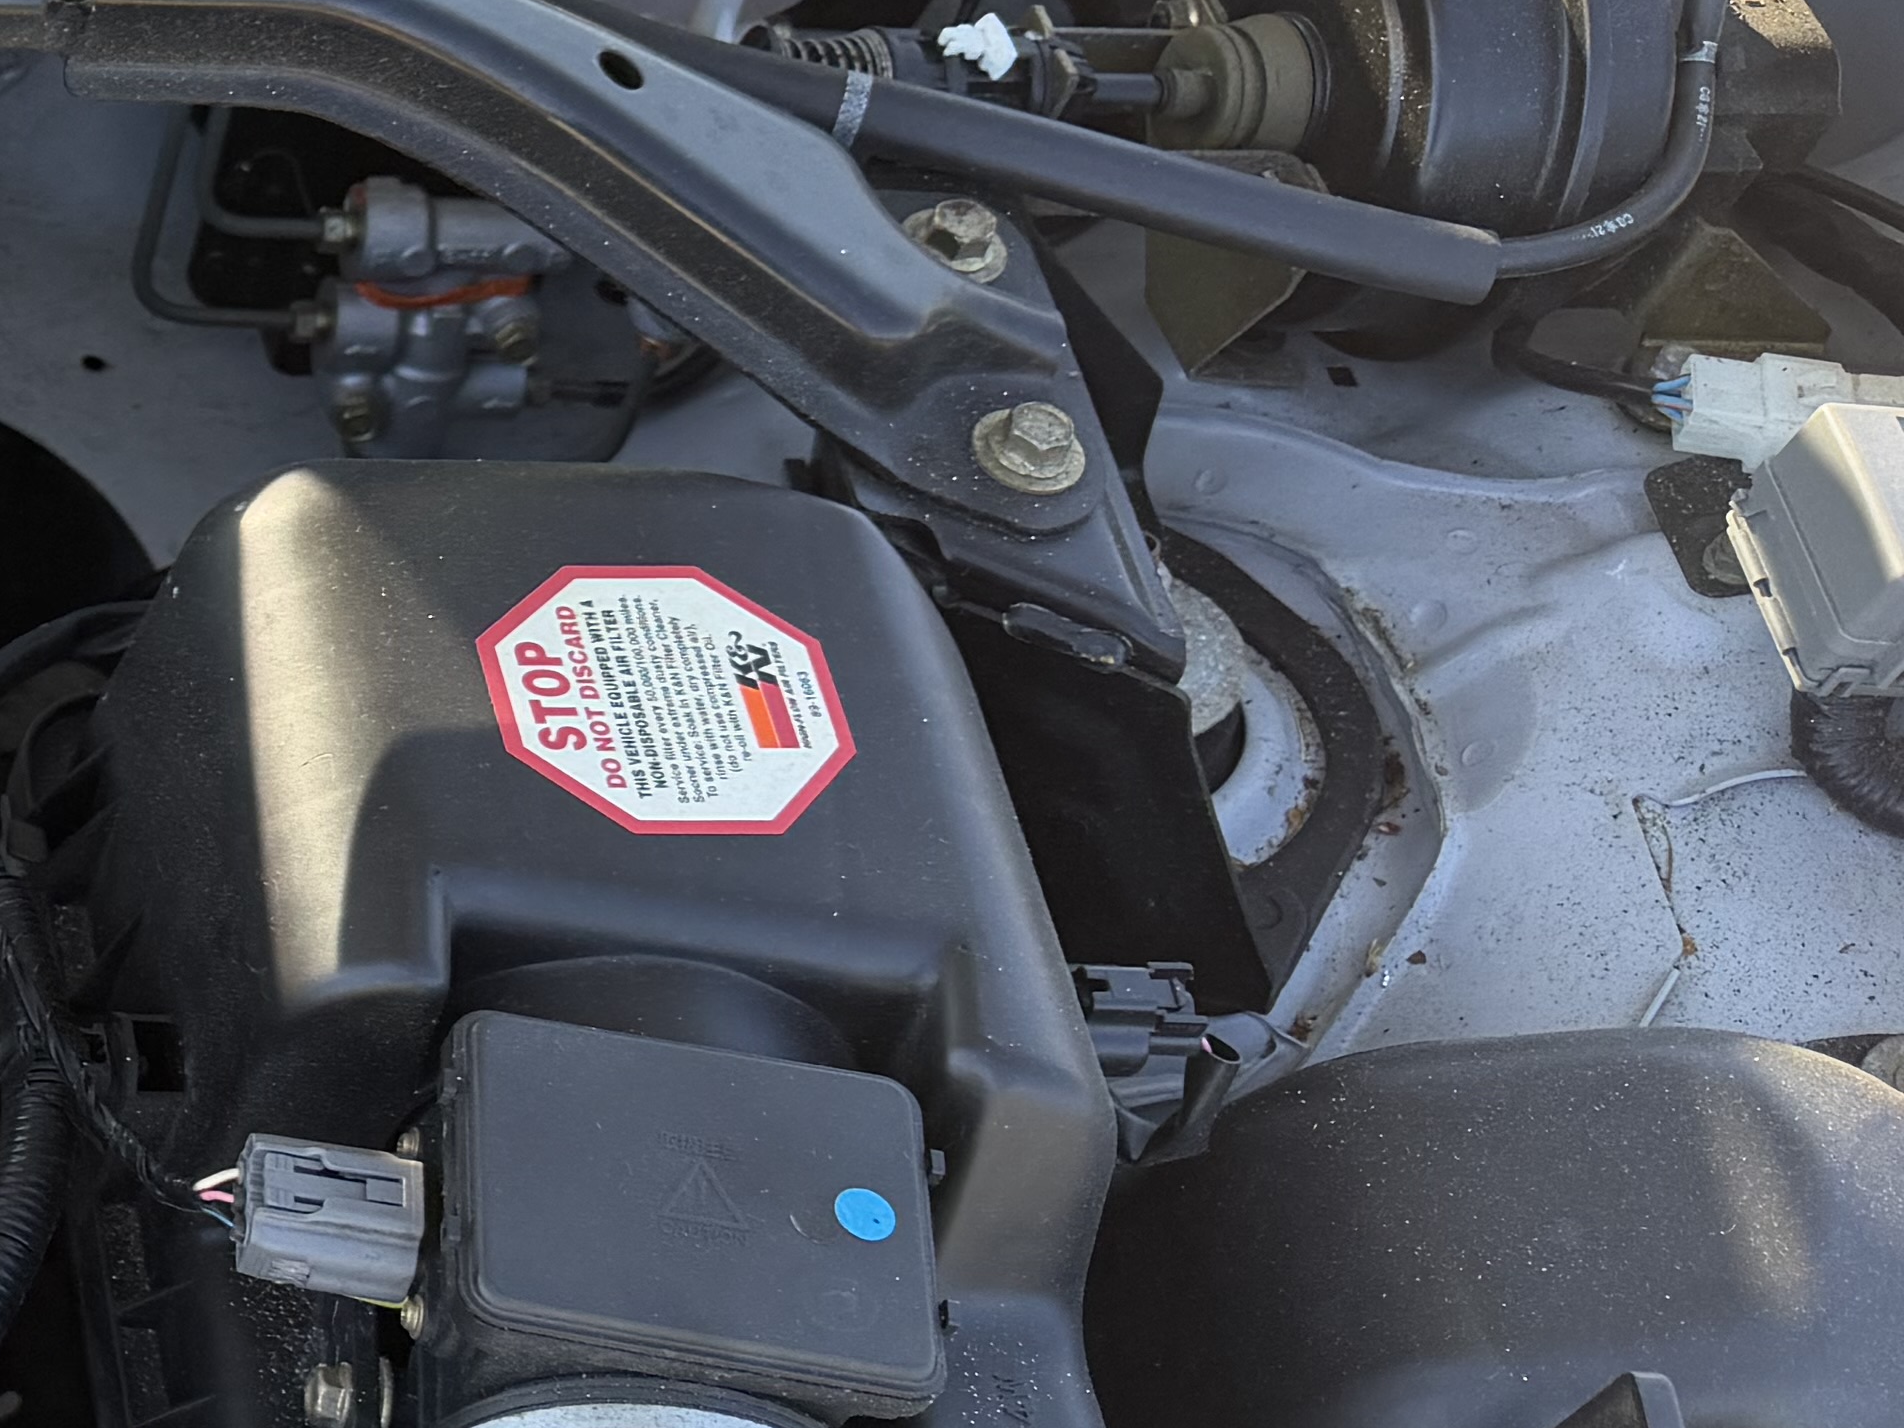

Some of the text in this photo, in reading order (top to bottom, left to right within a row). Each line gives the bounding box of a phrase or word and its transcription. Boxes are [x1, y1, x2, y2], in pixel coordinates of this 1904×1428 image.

[582, 612, 604, 643] WITH
[662, 644, 676, 669] Filter
[668, 616, 693, 671] completely
[594, 647, 623, 707] EQUIPPED
[651, 655, 667, 683] dusty
[690, 647, 719, 709] compressed
[708, 655, 725, 680] Filter
[514, 642, 587, 750] STOP
[556, 606, 627, 788] DO NOT DISCARD
[671, 673, 686, 695] K&N
[685, 675, 699, 691] dry
[716, 683, 733, 706] K&N
[602, 610, 668, 788] NON-DISPOSABLE AIR FILTER
[660, 686, 681, 727] extreme
[651, 706, 668, 734] every
[684, 712, 699, 737] Soak
[711, 713, 726, 731] use
[724, 710, 742, 731] with
[614, 712, 641, 765] VEHICLE
[660, 737, 676, 760] filter
[673, 731, 692, 761] under
[703, 728, 719, 750] with
[719, 734, 734, 752] not
[712, 754, 728, 779] rinse
[632, 770, 652, 798] THIS
[672, 764, 690, 803] Service
[687, 765, 705, 802] Sooner
